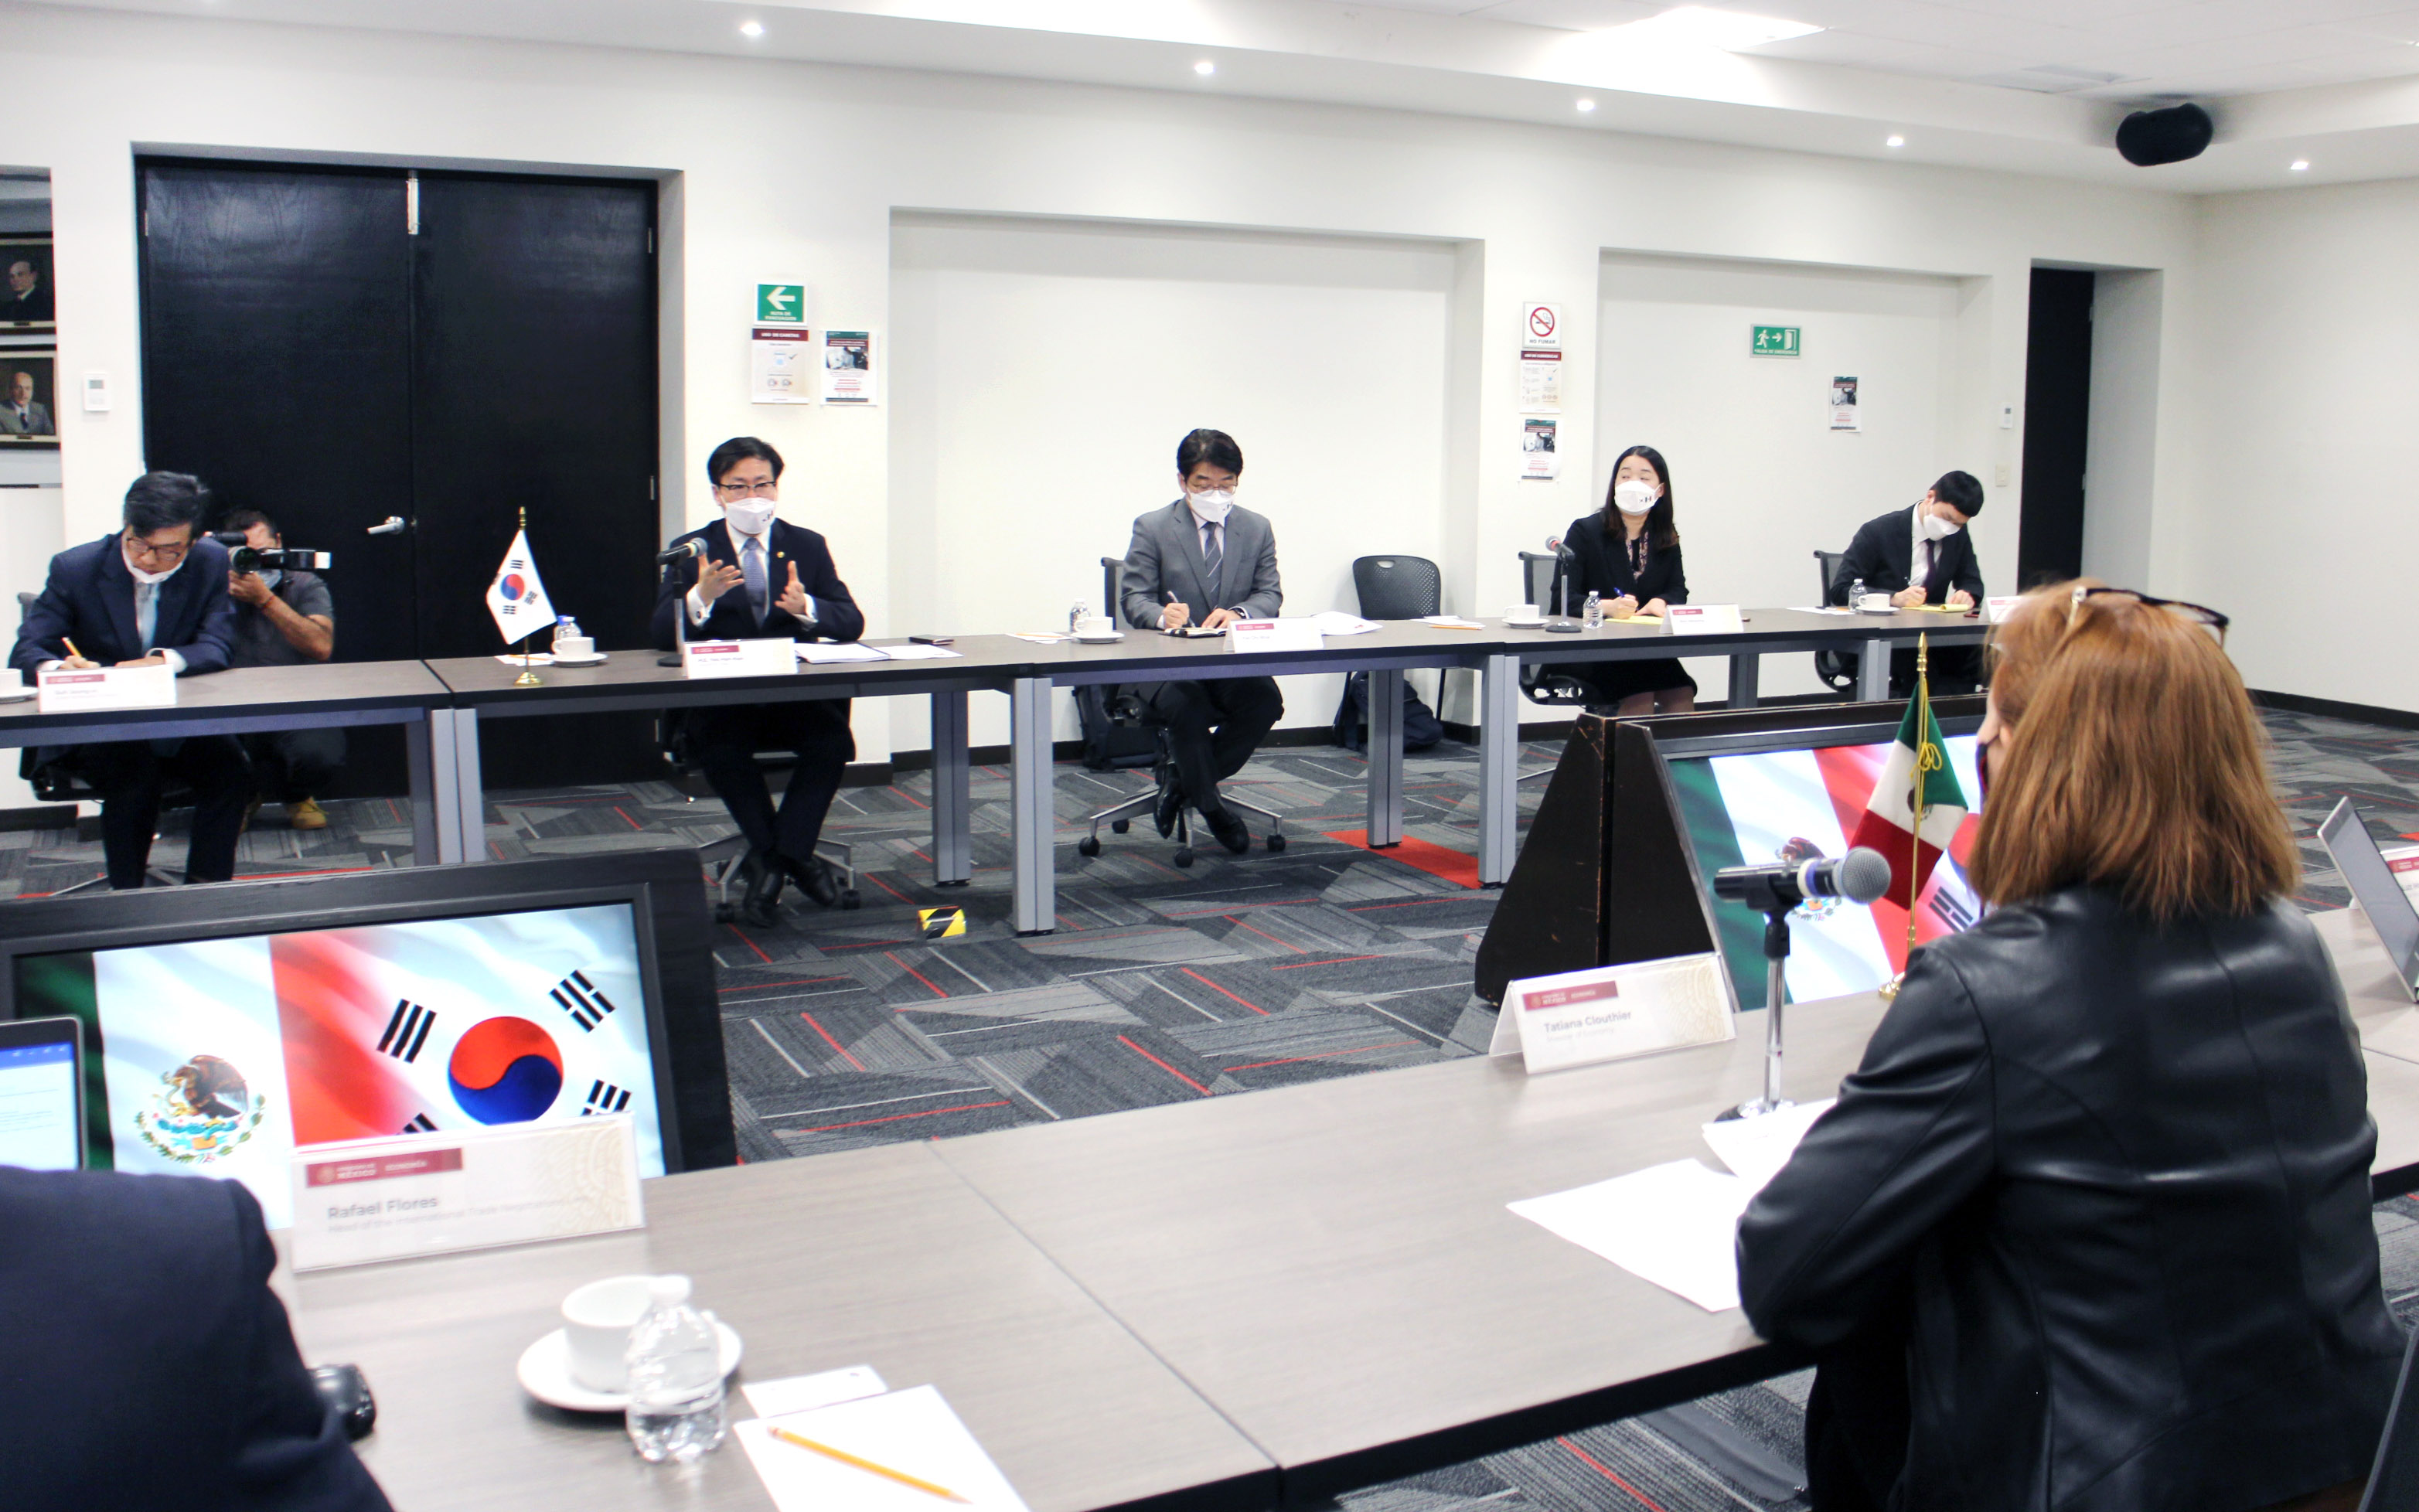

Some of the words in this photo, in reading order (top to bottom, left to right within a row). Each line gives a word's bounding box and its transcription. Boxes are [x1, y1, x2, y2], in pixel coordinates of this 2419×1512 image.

[1543, 1020, 1583, 1033] Tatiana
[1585, 1011, 1631, 1026] Clouthier
[328, 1200, 381, 1219] Rafael
[387, 1197, 438, 1213] Flores
